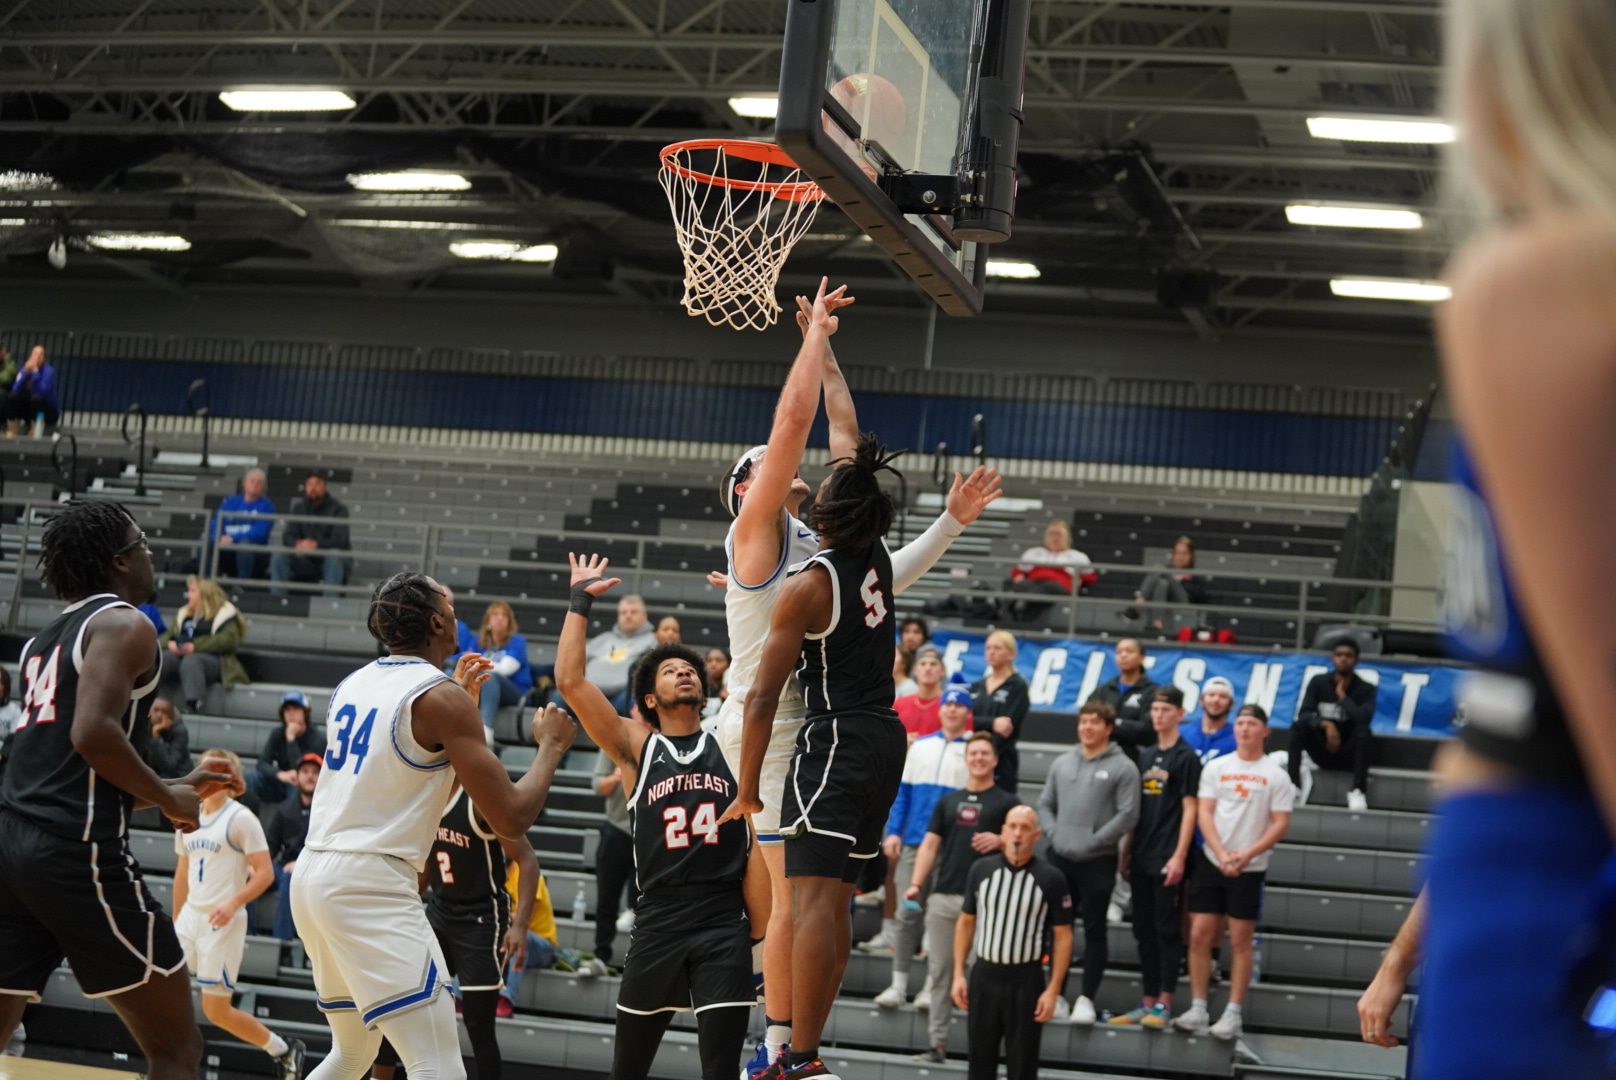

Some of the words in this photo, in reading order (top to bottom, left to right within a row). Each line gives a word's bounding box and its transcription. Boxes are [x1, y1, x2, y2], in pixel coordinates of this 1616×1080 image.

[860, 566, 888, 629] 5
[15, 643, 62, 732] 14
[326, 703, 378, 775] 34
[648, 773, 730, 806] NORTHEAST
[662, 801, 719, 850] 24
[198, 857, 205, 882] 1
[436, 851, 455, 884] 2
